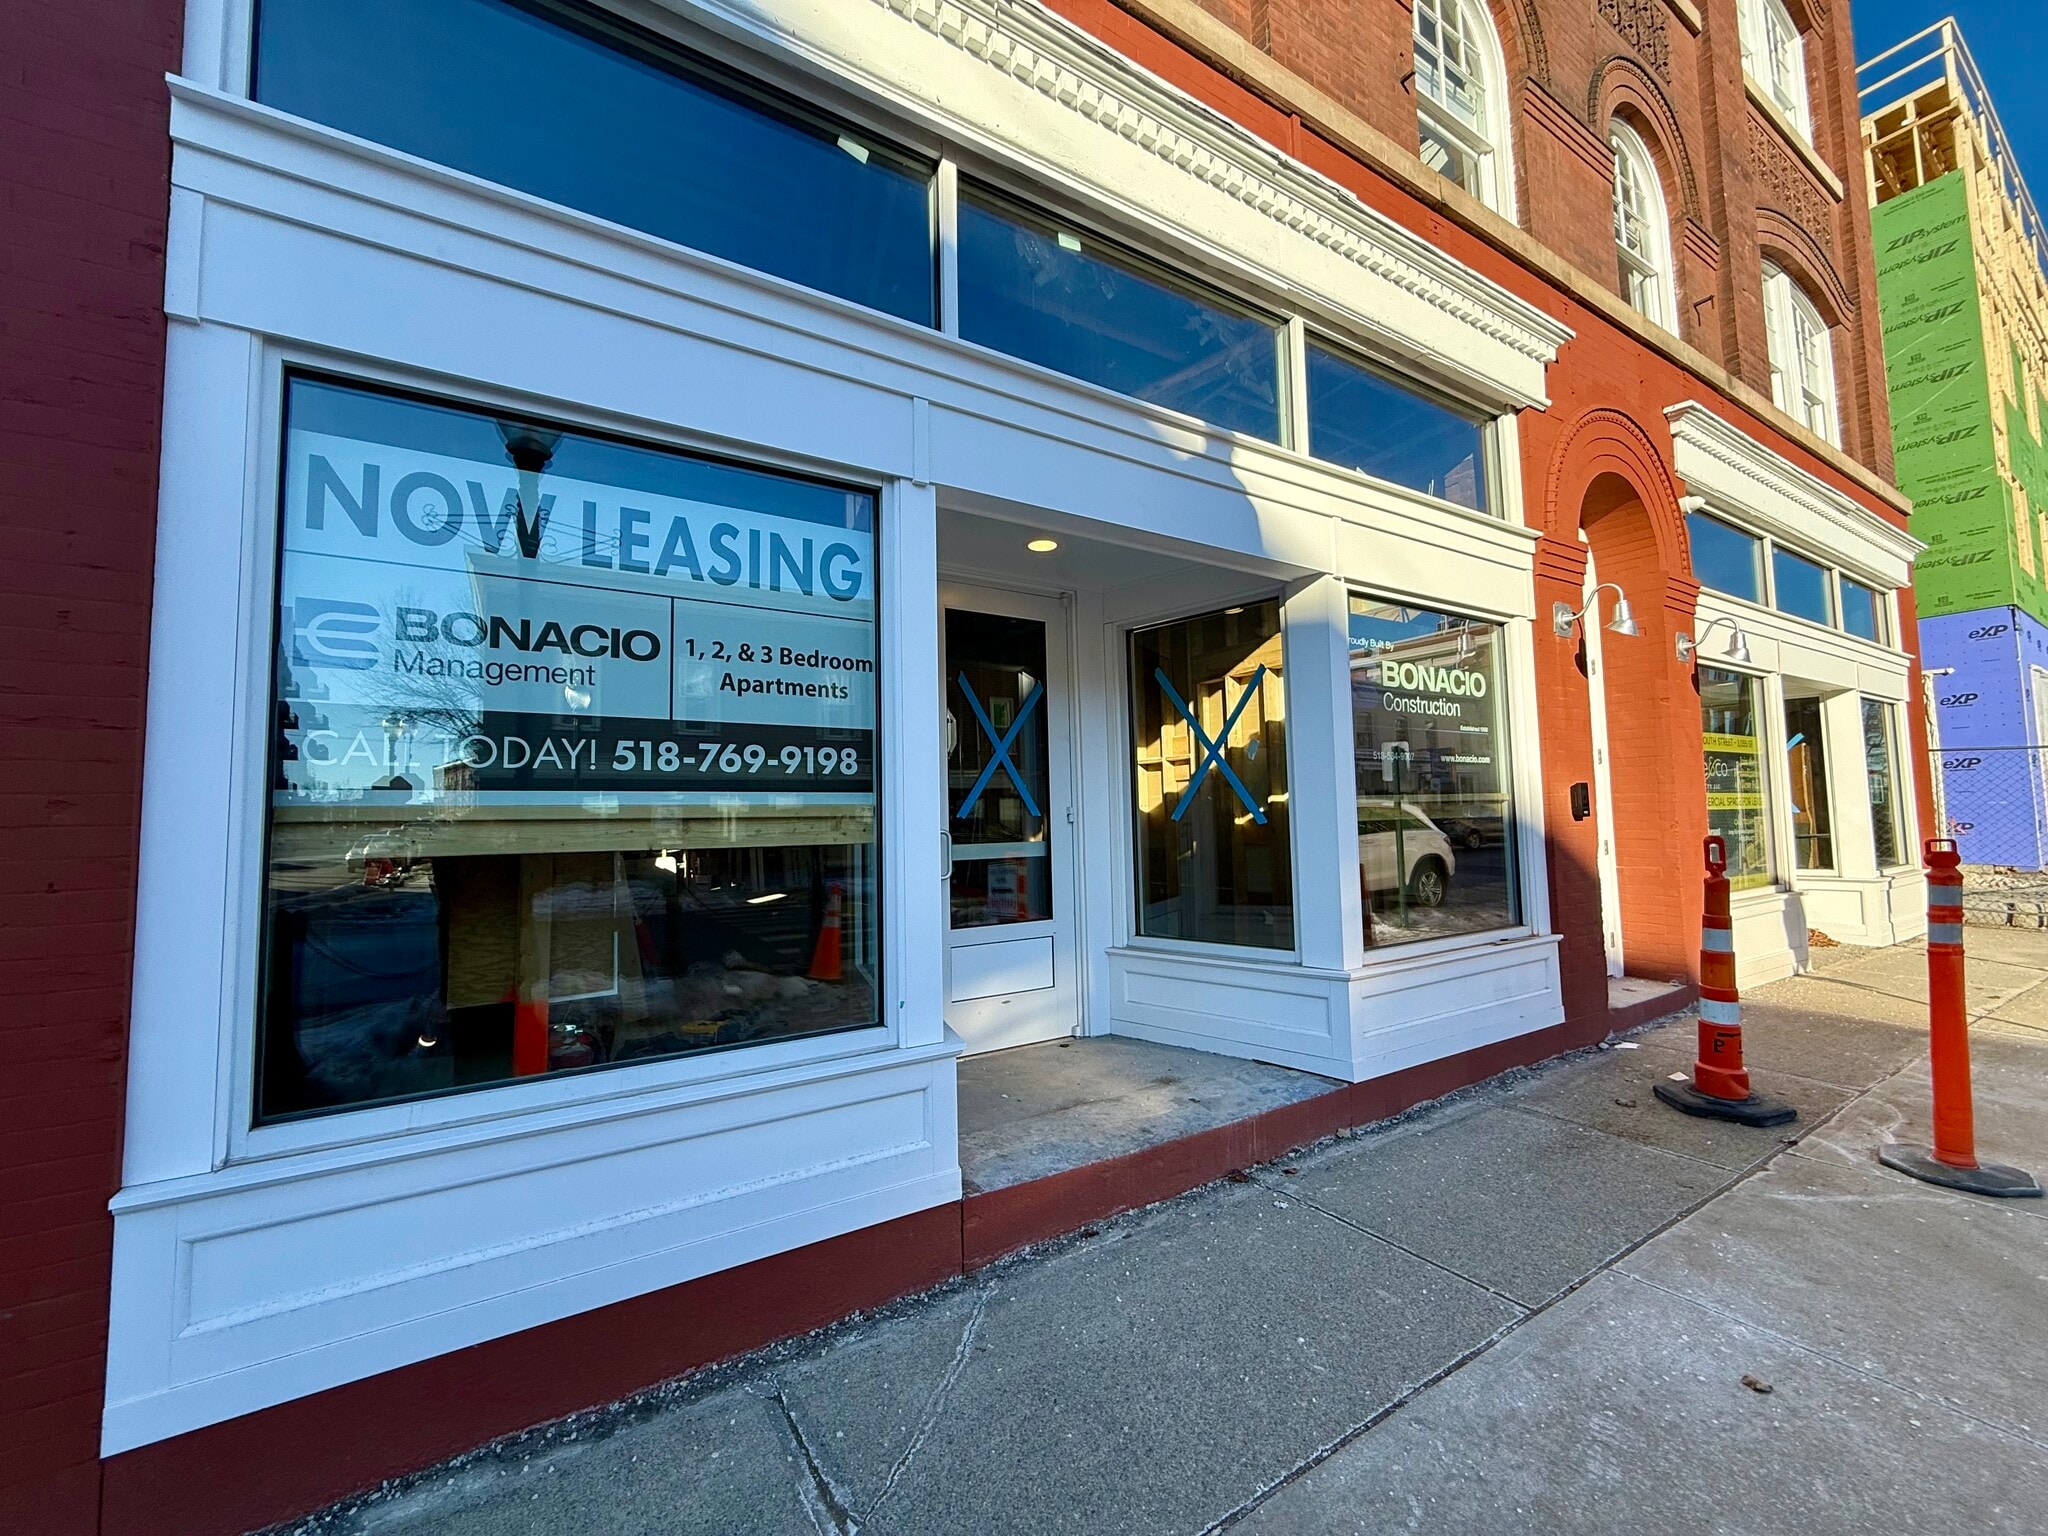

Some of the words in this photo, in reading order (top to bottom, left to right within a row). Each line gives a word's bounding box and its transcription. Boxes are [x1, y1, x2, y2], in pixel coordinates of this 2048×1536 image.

[304, 453, 556, 559] NOW
[581, 499, 863, 602] LEASING
[395, 606, 662, 662] BONACIO
[1348, 636, 1369, 649] roudly
[1385, 640, 1395, 652] By
[394, 648, 597, 687] Management
[685, 638, 705, 661] 1,
[711, 641, 732, 663] 2,
[738, 643, 755, 663] &
[760, 645, 773, 664] 3
[780, 647, 873, 673] Bedroom
[719, 672, 849, 700] Apartments
[1381, 660, 1487, 698] BONACIO
[1383, 692, 1461, 718] Construction
[302, 729, 421, 767] CALL
[435, 734, 597, 771] TODAY!
[612, 739, 859, 775] 518-769-9198
[1702, 736, 1717, 746] OUTH
[1717, 737, 1734, 747] STREET
[1440, 753, 1490, 764] www.bonacio.com
[1707, 796, 1726, 807] ERCIAL
